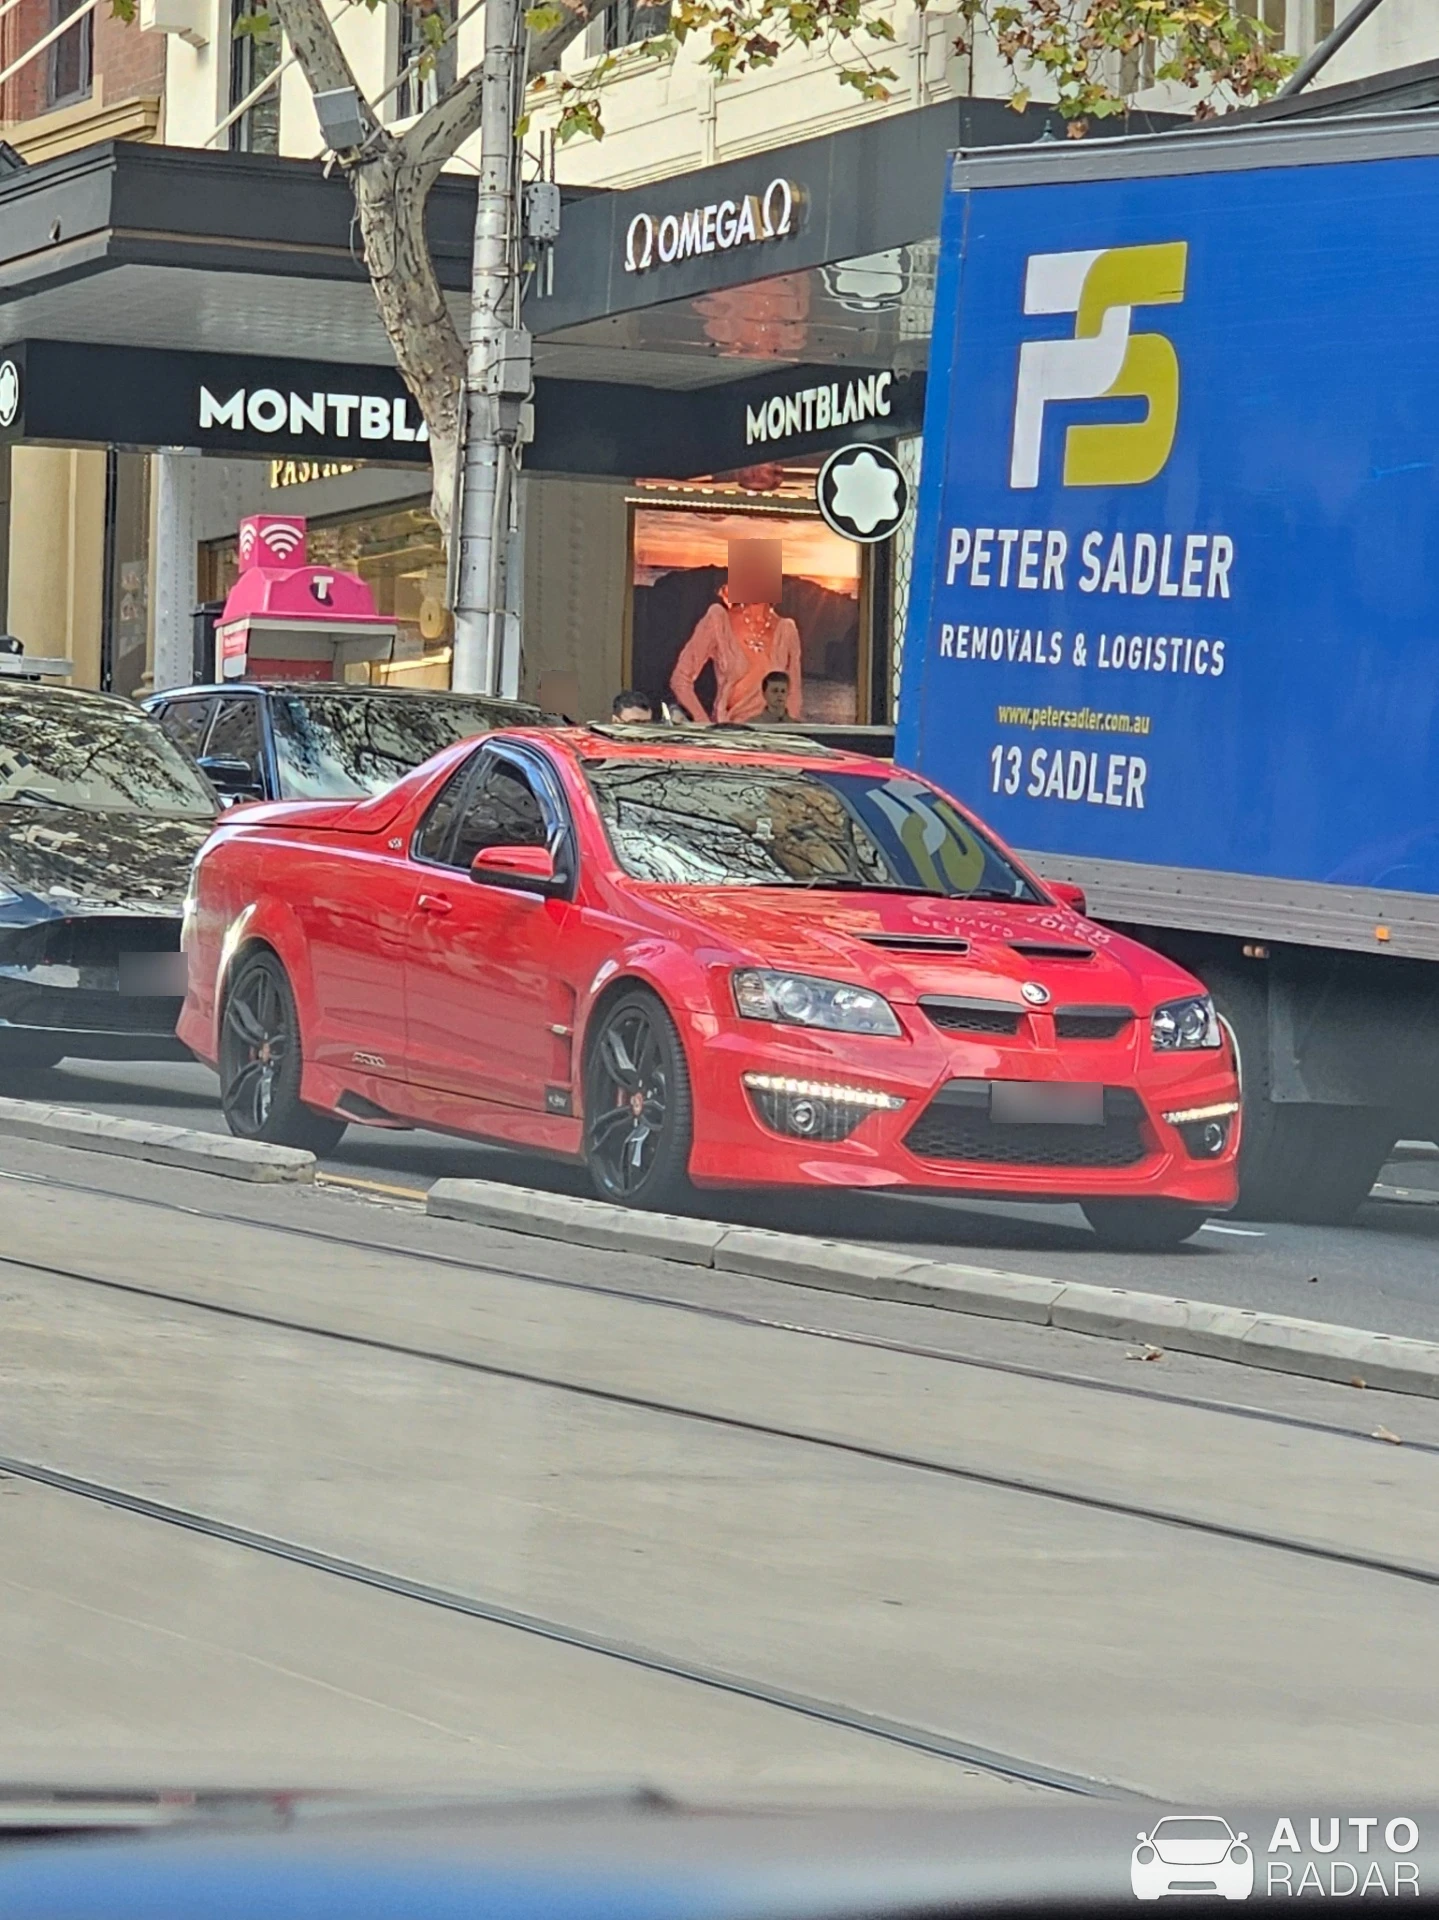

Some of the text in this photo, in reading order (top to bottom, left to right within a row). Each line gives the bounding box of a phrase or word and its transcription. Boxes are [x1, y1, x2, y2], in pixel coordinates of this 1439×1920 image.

[658, 195, 757, 263] OMEGA
[199, 385, 431, 443] MONTBL
[746, 371, 892, 446] MONTBLANC
[313, 576, 334, 600] T
[946, 527, 1234, 599] PETER SADLER
[940, 623, 1226, 677] REMOVALS & LOGISTICS
[997, 704, 1151, 735] www.petersadler.com.au
[991, 744, 1148, 809] 13 SADLER
